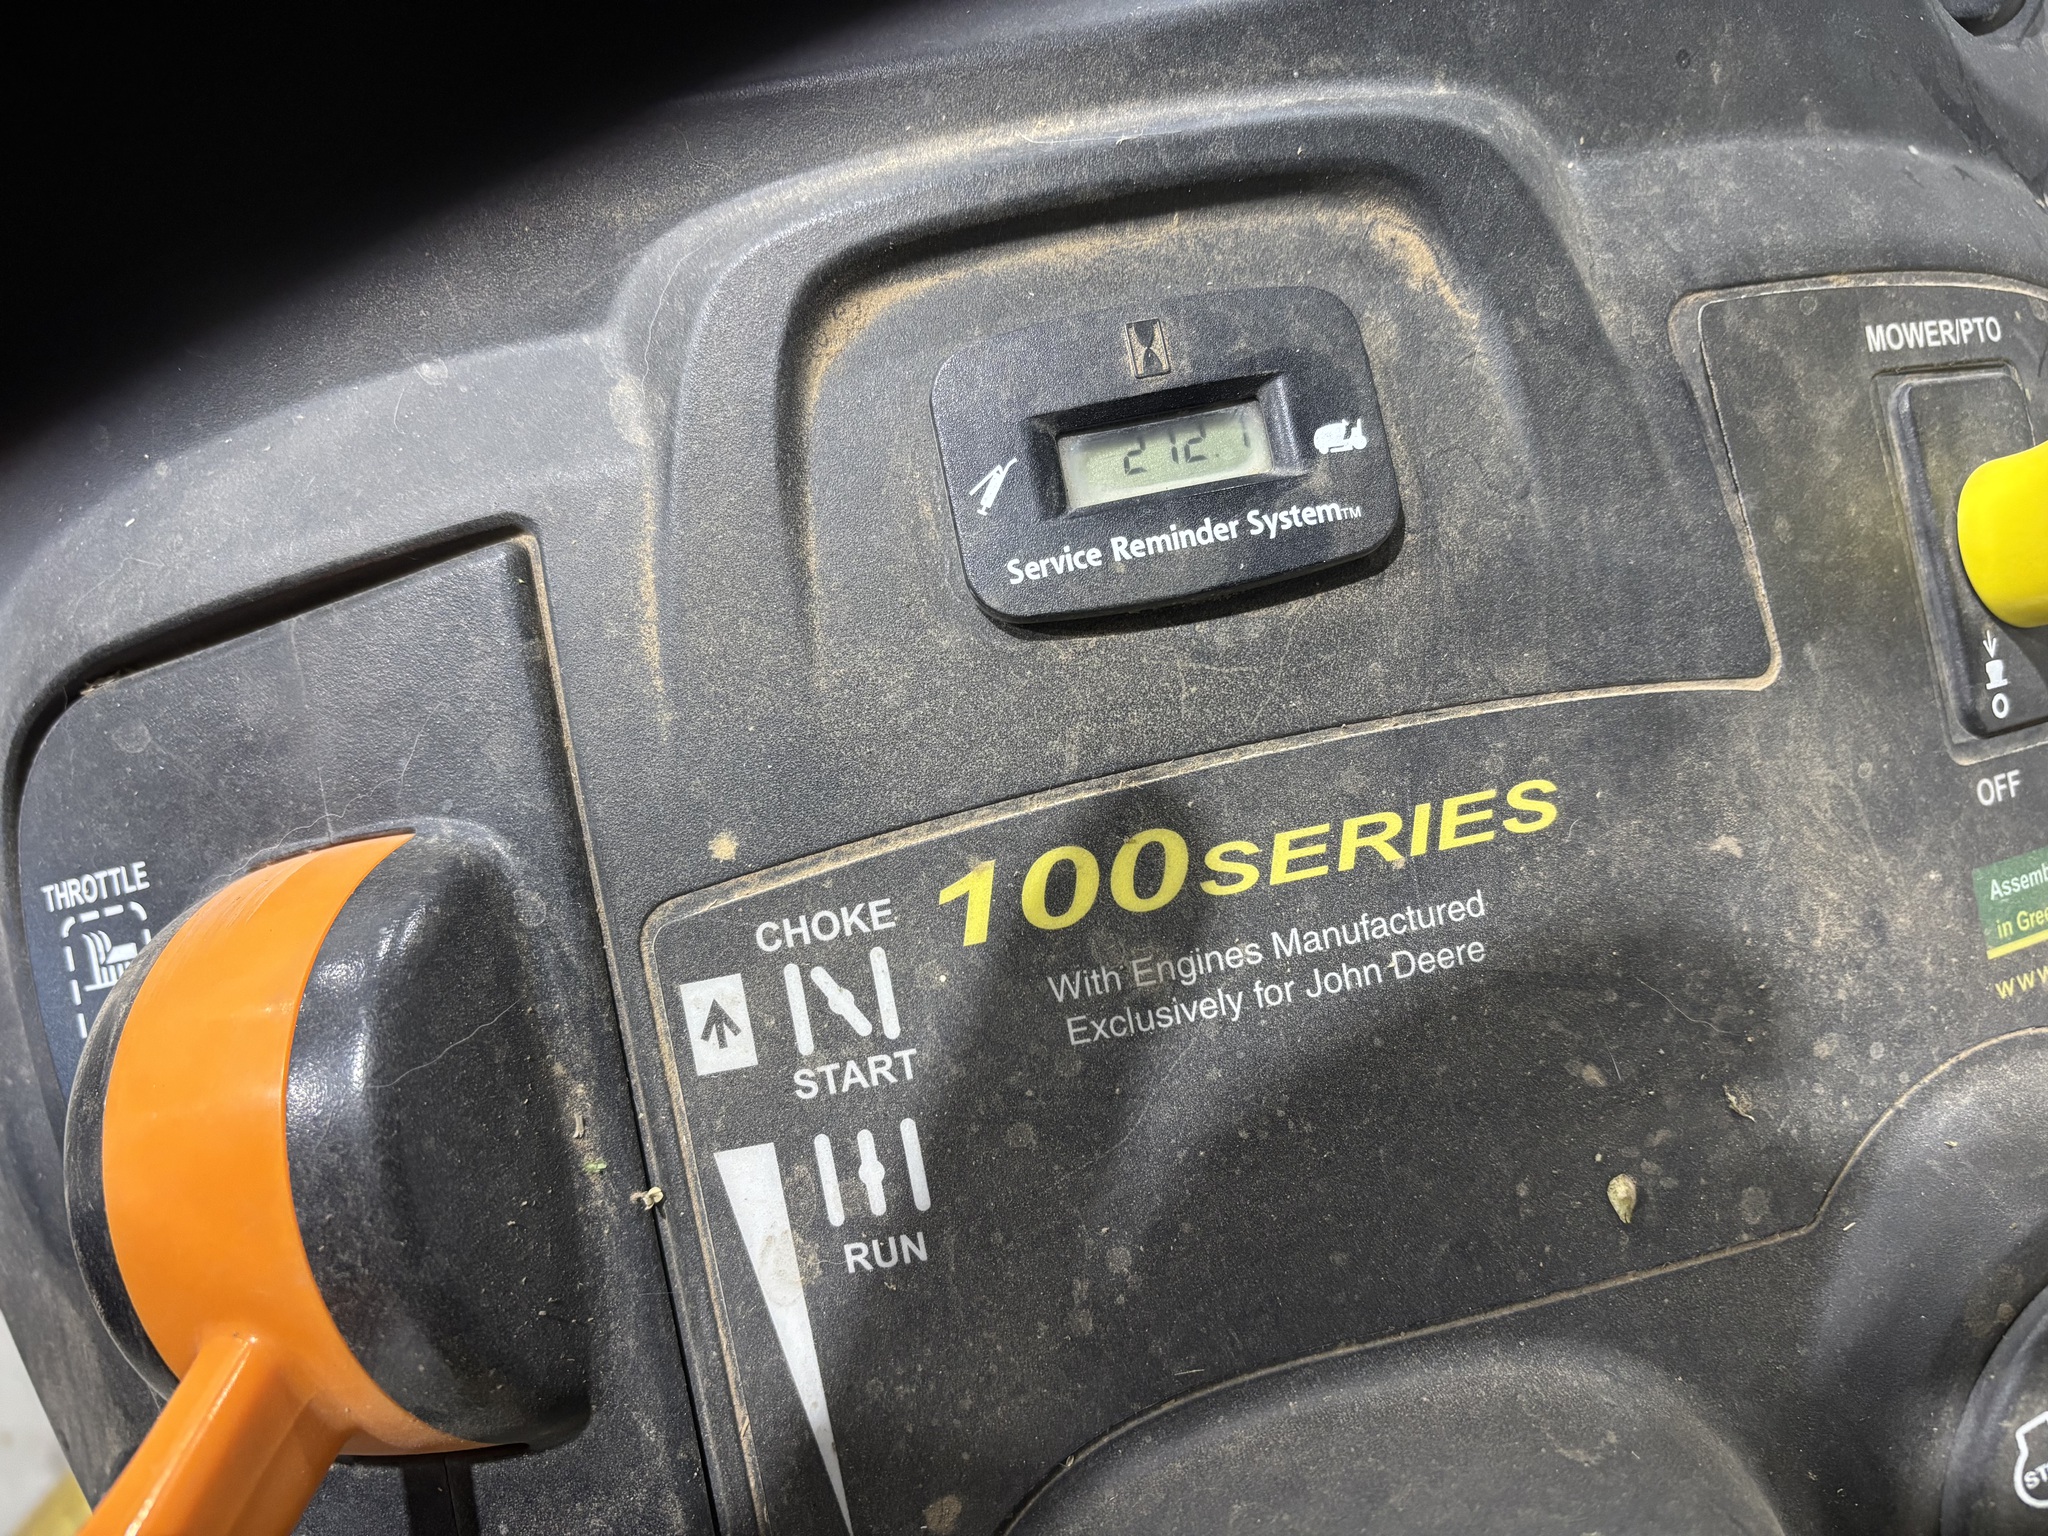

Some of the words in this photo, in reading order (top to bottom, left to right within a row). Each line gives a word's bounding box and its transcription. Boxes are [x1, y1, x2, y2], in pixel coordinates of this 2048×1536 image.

[1865, 316, 2002, 352] MOWER/PTO
[1006, 546, 1102, 584] Service
[1111, 515, 1239, 562] Reminder
[1976, 769, 2021, 806] OFF
[40, 861, 150, 912] THROTTLE
[755, 898, 896, 952] CHOKE
[1048, 968, 1121, 1004] With
[1132, 938, 1263, 989] Engines
[1272, 890, 1486, 958] Manufactured
[1996, 919, 2014, 939] in
[1067, 988, 1243, 1046] Exclusively
[1252, 979, 1294, 1008] for
[1305, 958, 1383, 1000] John
[1393, 939, 1486, 979] Deere
[793, 1048, 917, 1100] START
[843, 1232, 928, 1274] RUN
